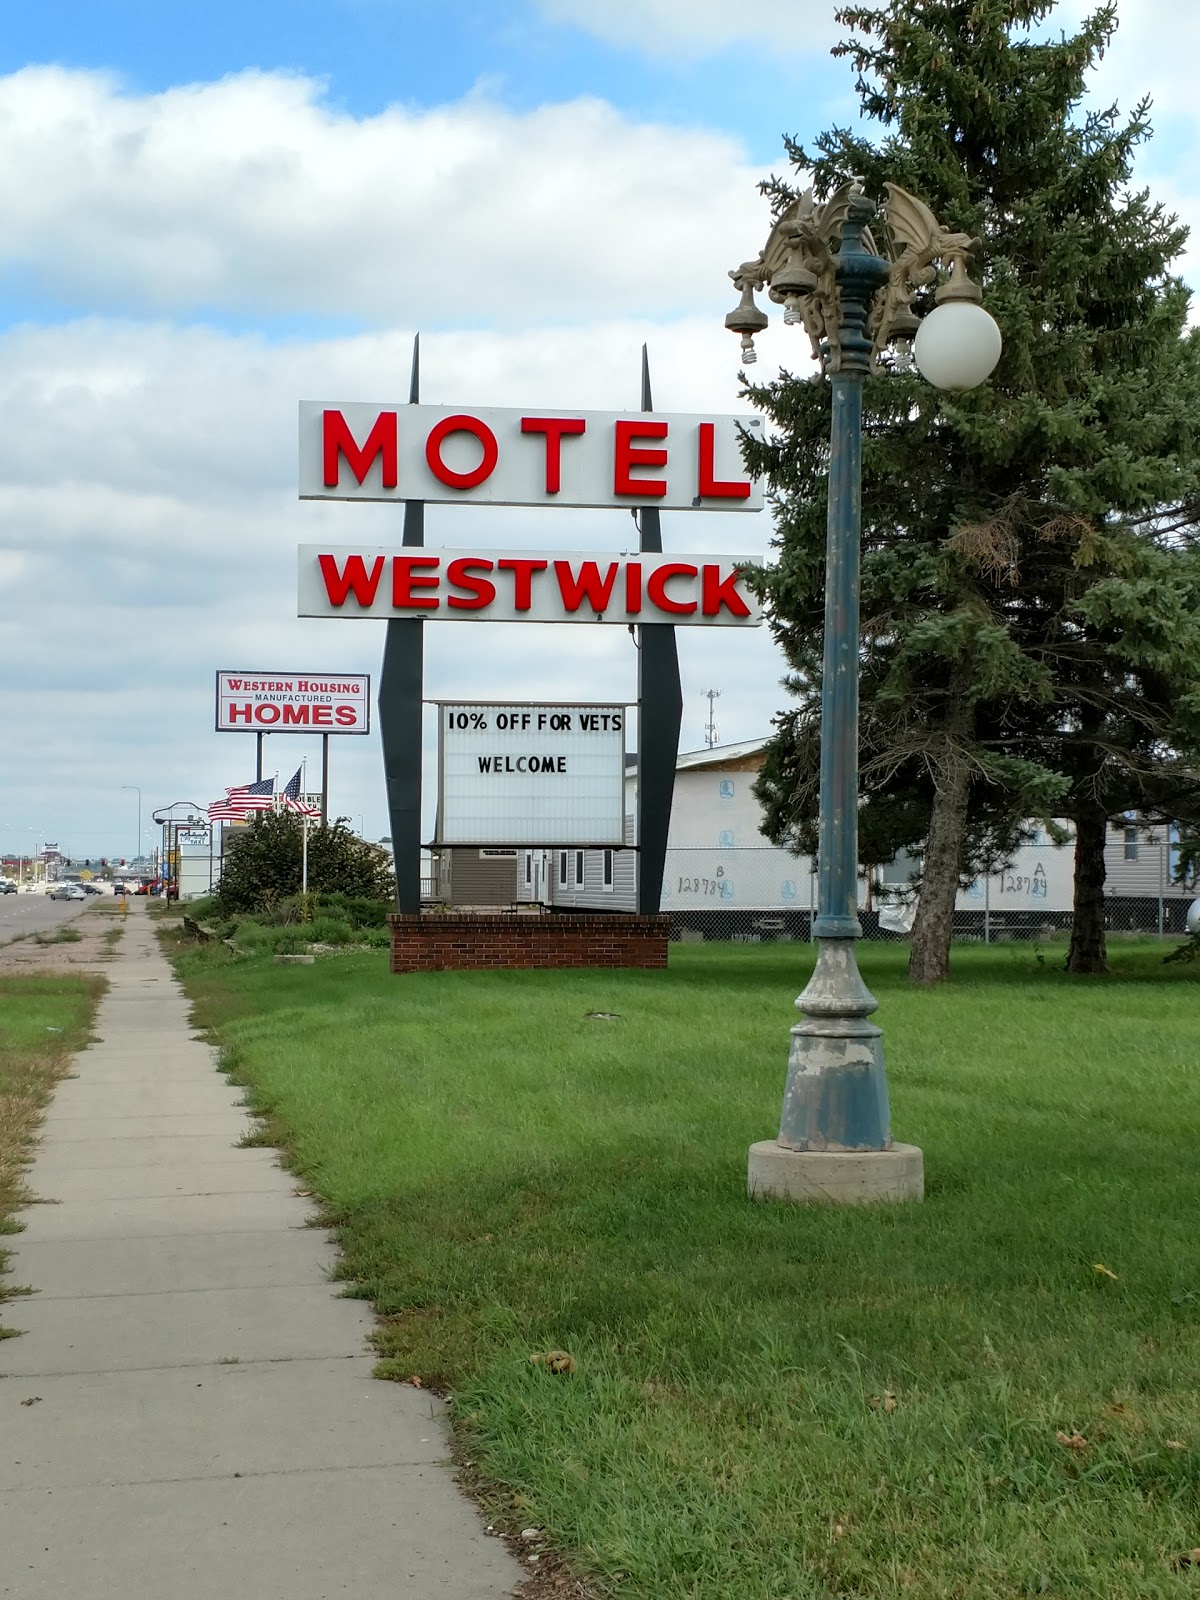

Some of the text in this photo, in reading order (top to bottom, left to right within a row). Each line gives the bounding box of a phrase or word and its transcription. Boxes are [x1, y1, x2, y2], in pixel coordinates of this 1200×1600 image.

[322, 409, 751, 499] MOTEL
[317, 554, 752, 618] WESTWICK
[227, 678, 360, 694] WESTERN HOUSING
[254, 694, 332, 702] MANUFACTURED
[229, 703, 358, 726] HOMES
[449, 712, 622, 731] 10% OFF FOR VETS
[478, 756, 567, 773] WELCOME
[716, 865, 725, 877] B
[1034, 863, 1045, 877] A
[678, 877, 725, 899] 128784
[1000, 873, 1047, 898] 128784
